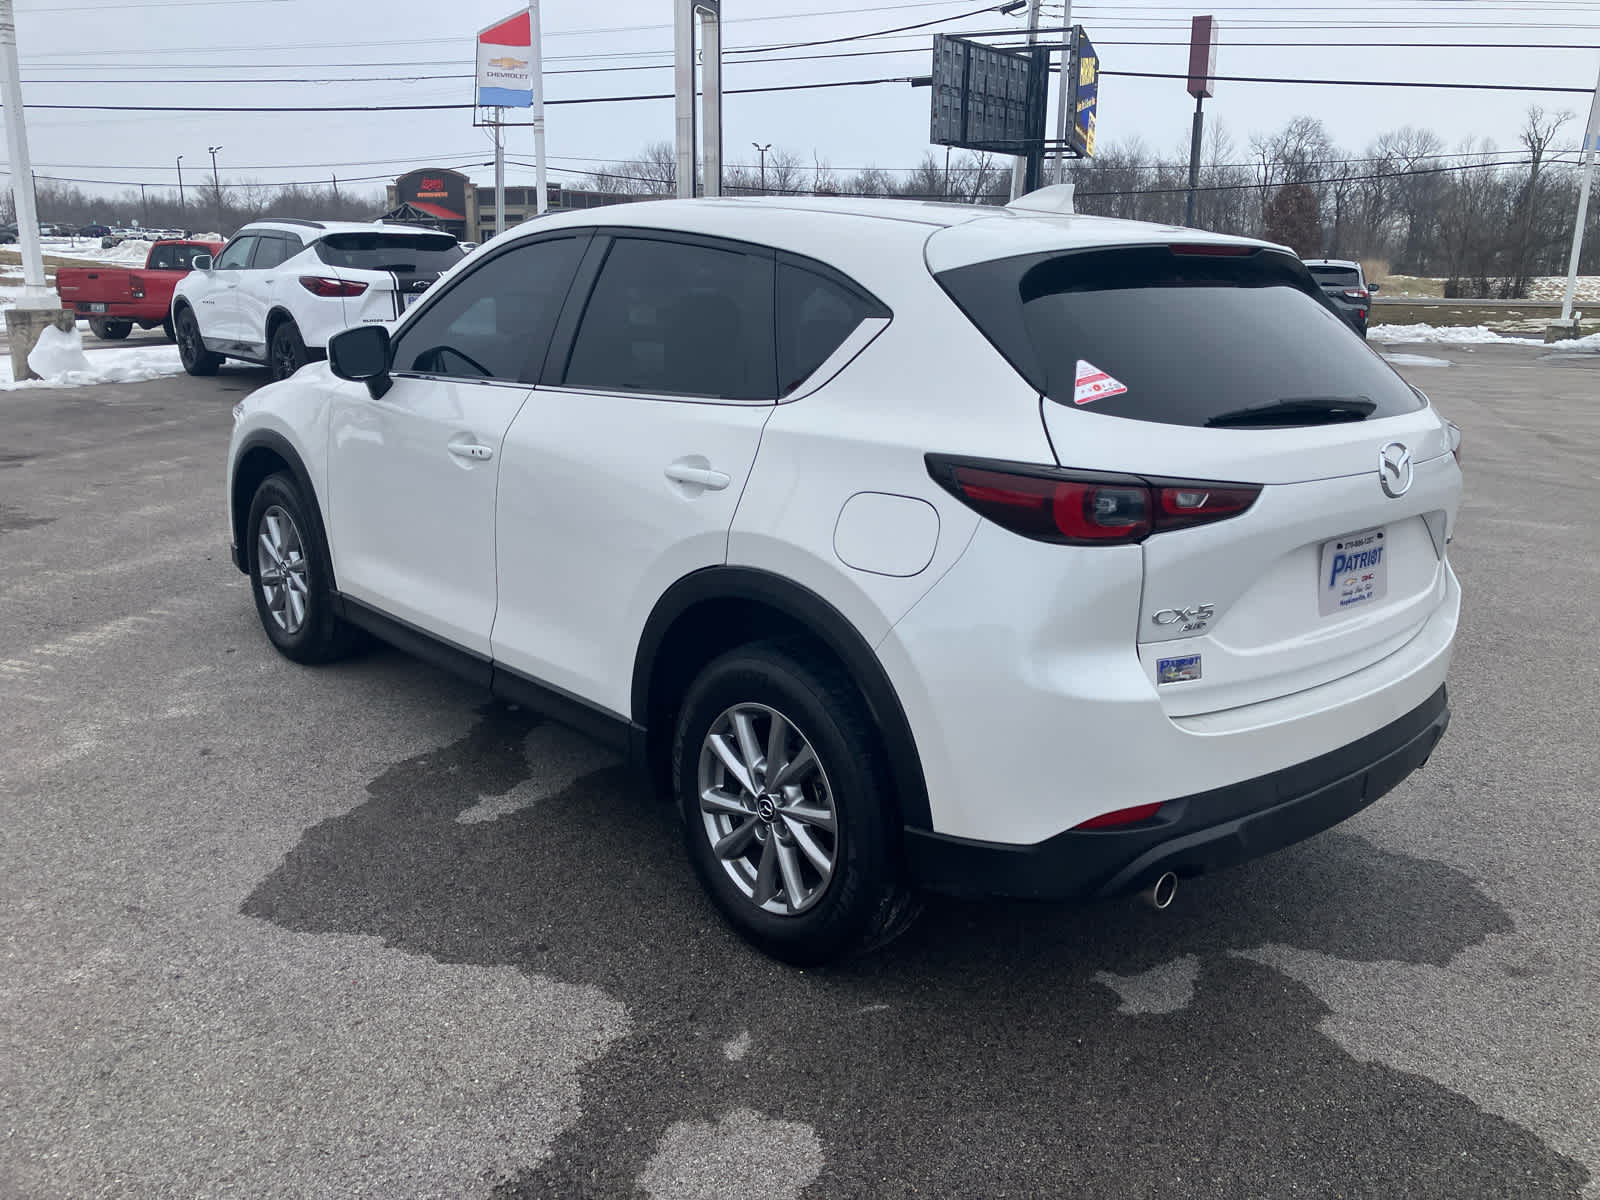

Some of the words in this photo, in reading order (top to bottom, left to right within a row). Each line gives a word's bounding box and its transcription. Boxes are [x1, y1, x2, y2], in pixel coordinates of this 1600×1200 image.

[486, 71, 529, 80] CHEVROLET
[1329, 546, 1384, 587] PATRIOT
[1151, 602, 1215, 625] CX-5
